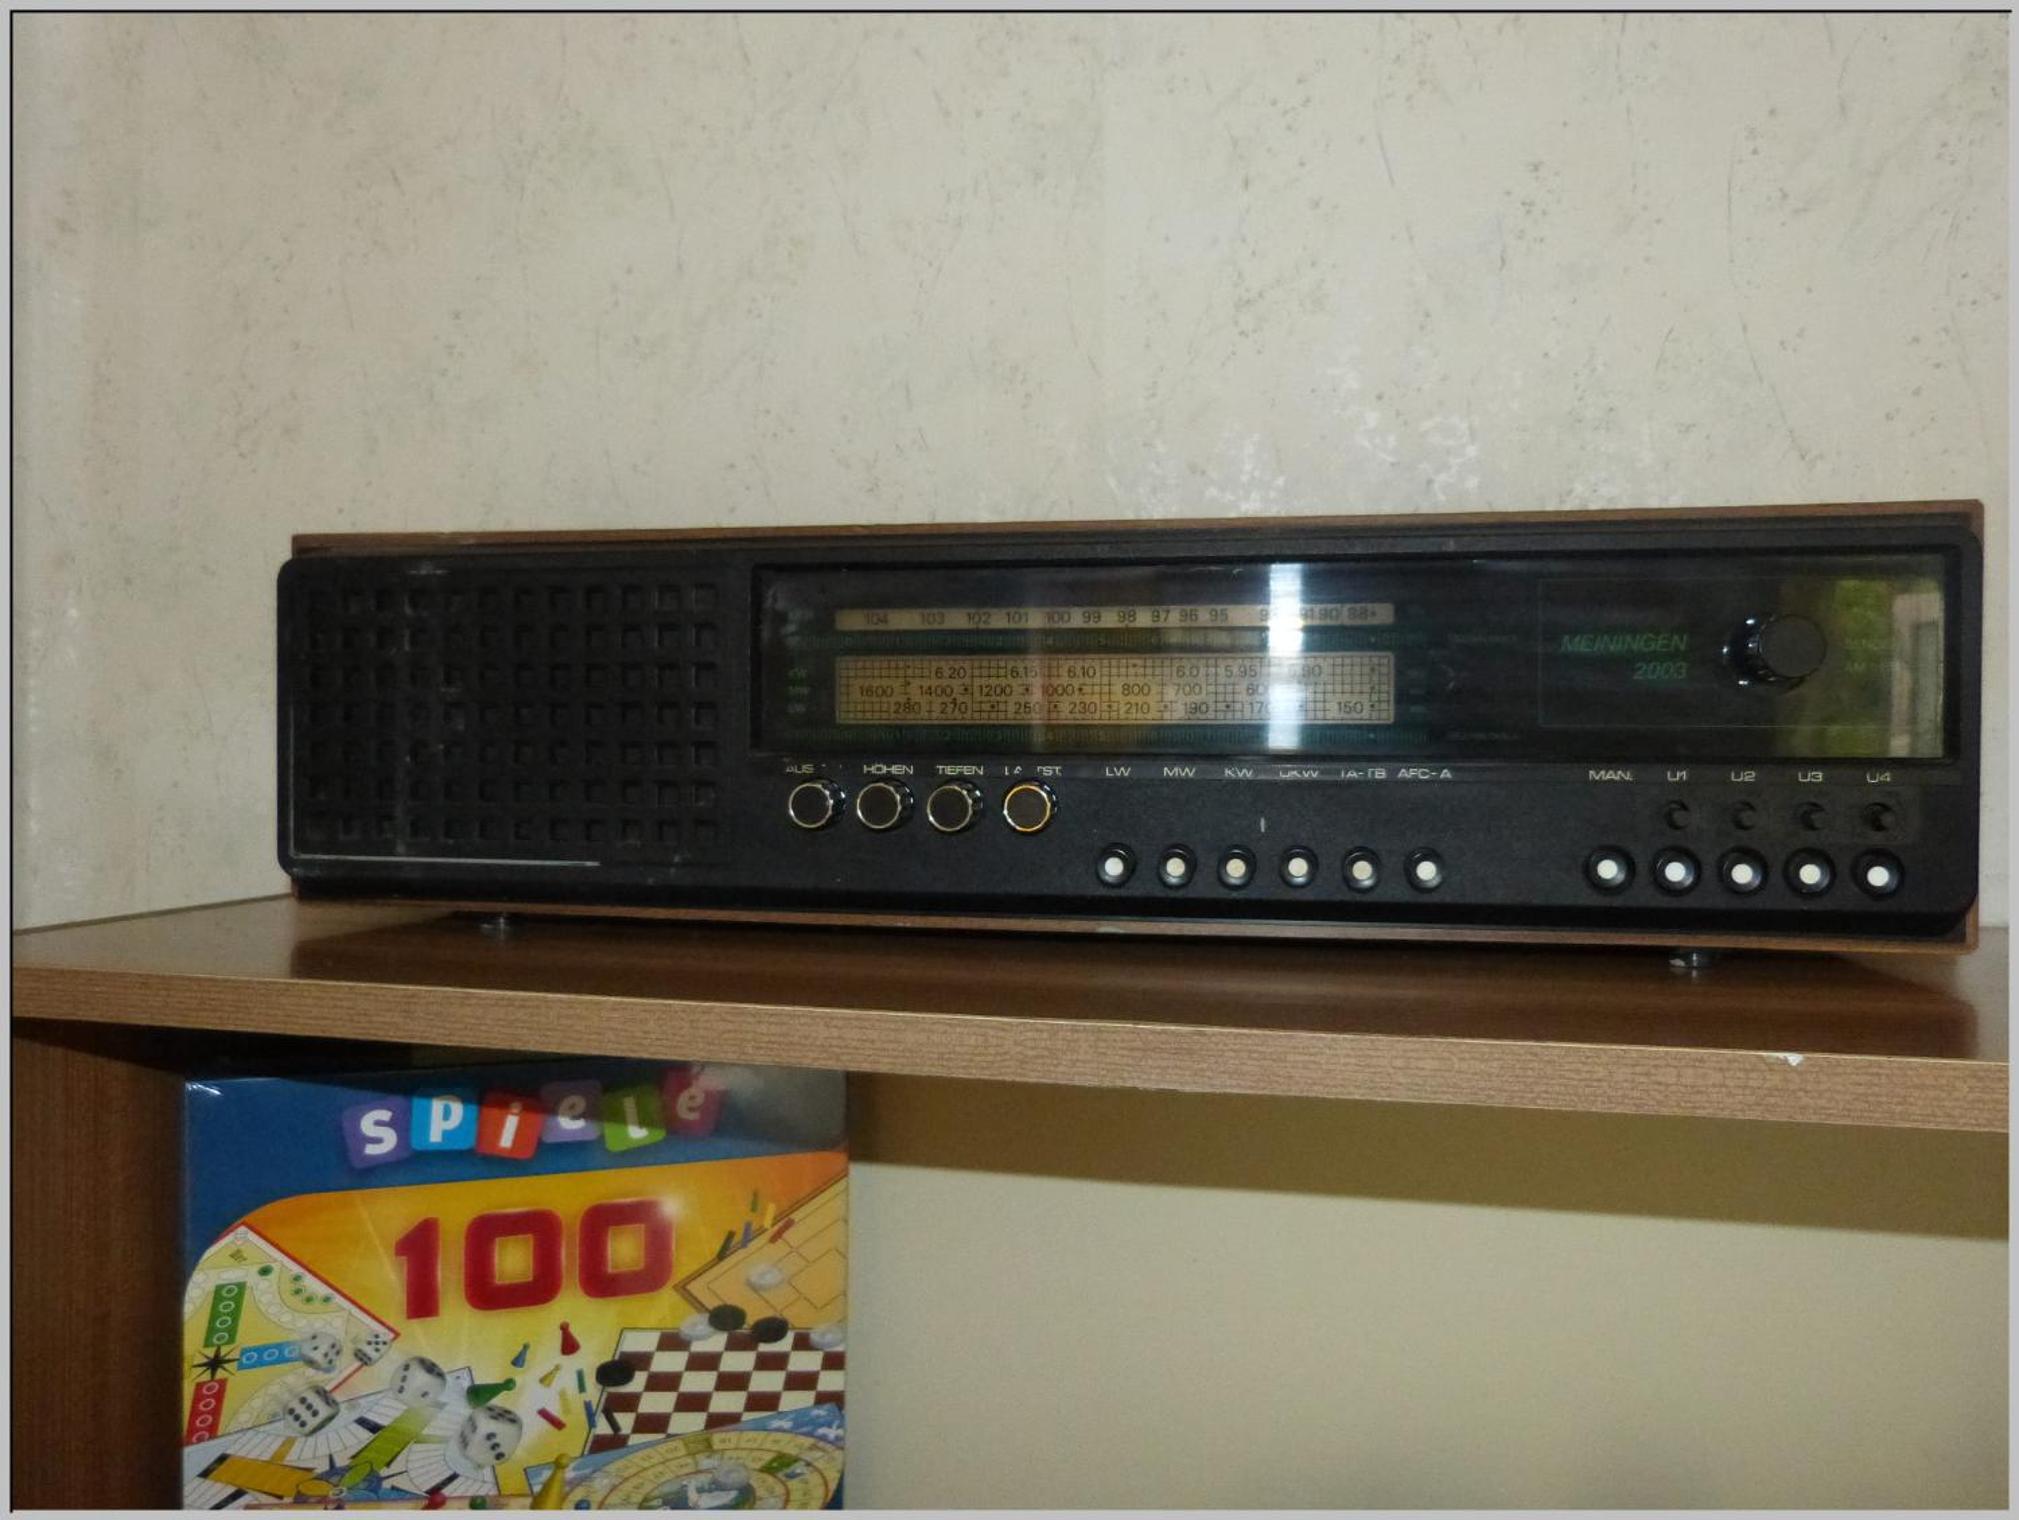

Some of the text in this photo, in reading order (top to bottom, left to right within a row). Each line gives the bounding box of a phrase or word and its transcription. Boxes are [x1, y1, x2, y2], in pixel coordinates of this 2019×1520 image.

[866, 611, 888, 625] 104
[921, 611, 945, 625] 103
[967, 611, 991, 625] 102
[1006, 610, 1029, 625] 101
[1046, 610, 1071, 625] 100
[1082, 610, 1101, 624] 99
[1117, 609, 1137, 623] 98
[1151, 608, 1170, 622] 97
[1178, 608, 1199, 622] 96
[1208, 607, 1228, 622] 95
[1560, 632, 1688, 653] MEININGEN
[934, 666, 967, 679] 6.20
[1010, 665, 1037, 679] 6.15
[1067, 665, 1097, 679] 6.10
[1632, 661, 1689, 680] 2003
[859, 685, 894, 698] 1600
[919, 685, 954, 698] 1400
[978, 684, 1013, 697] 1200
[1042, 683, 1075, 697] 1000
[1121, 683, 1151, 696] 800
[1174, 682, 1202, 696] 700
[893, 702, 921, 714] 280
[940, 702, 968, 714] 270
[1068, 701, 1097, 714] 230
[1124, 701, 1151, 714] 210
[1184, 702, 1209, 715] 190
[1336, 701, 1364, 714] 150
[863, 763, 914, 775] HÖHEN
[936, 765, 984, 775] TIEFEN
[1105, 766, 1131, 777] LW
[1163, 766, 1196, 777] MW
[1224, 767, 1254, 777] KW
[1588, 769, 1634, 782] MAN.
[1667, 770, 1688, 782] U1
[1730, 770, 1756, 782] U2
[1797, 771, 1824, 782] U3
[1865, 771, 1892, 783] U4
[395, 1199, 676, 1320] 100
